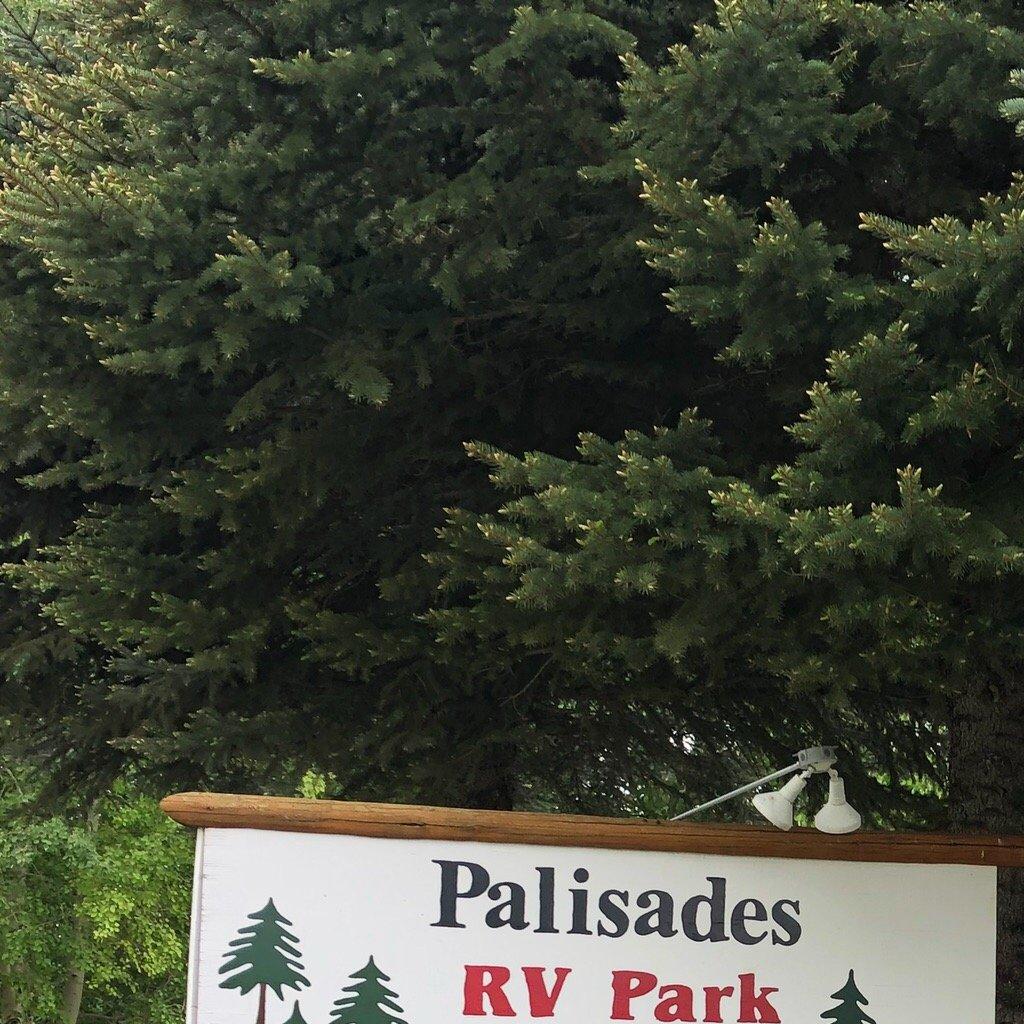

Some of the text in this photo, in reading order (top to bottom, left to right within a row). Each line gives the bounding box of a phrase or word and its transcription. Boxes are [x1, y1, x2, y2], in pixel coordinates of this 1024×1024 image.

[429, 859, 802, 947] Palisades
[462, 964, 782, 1024] RV Park
